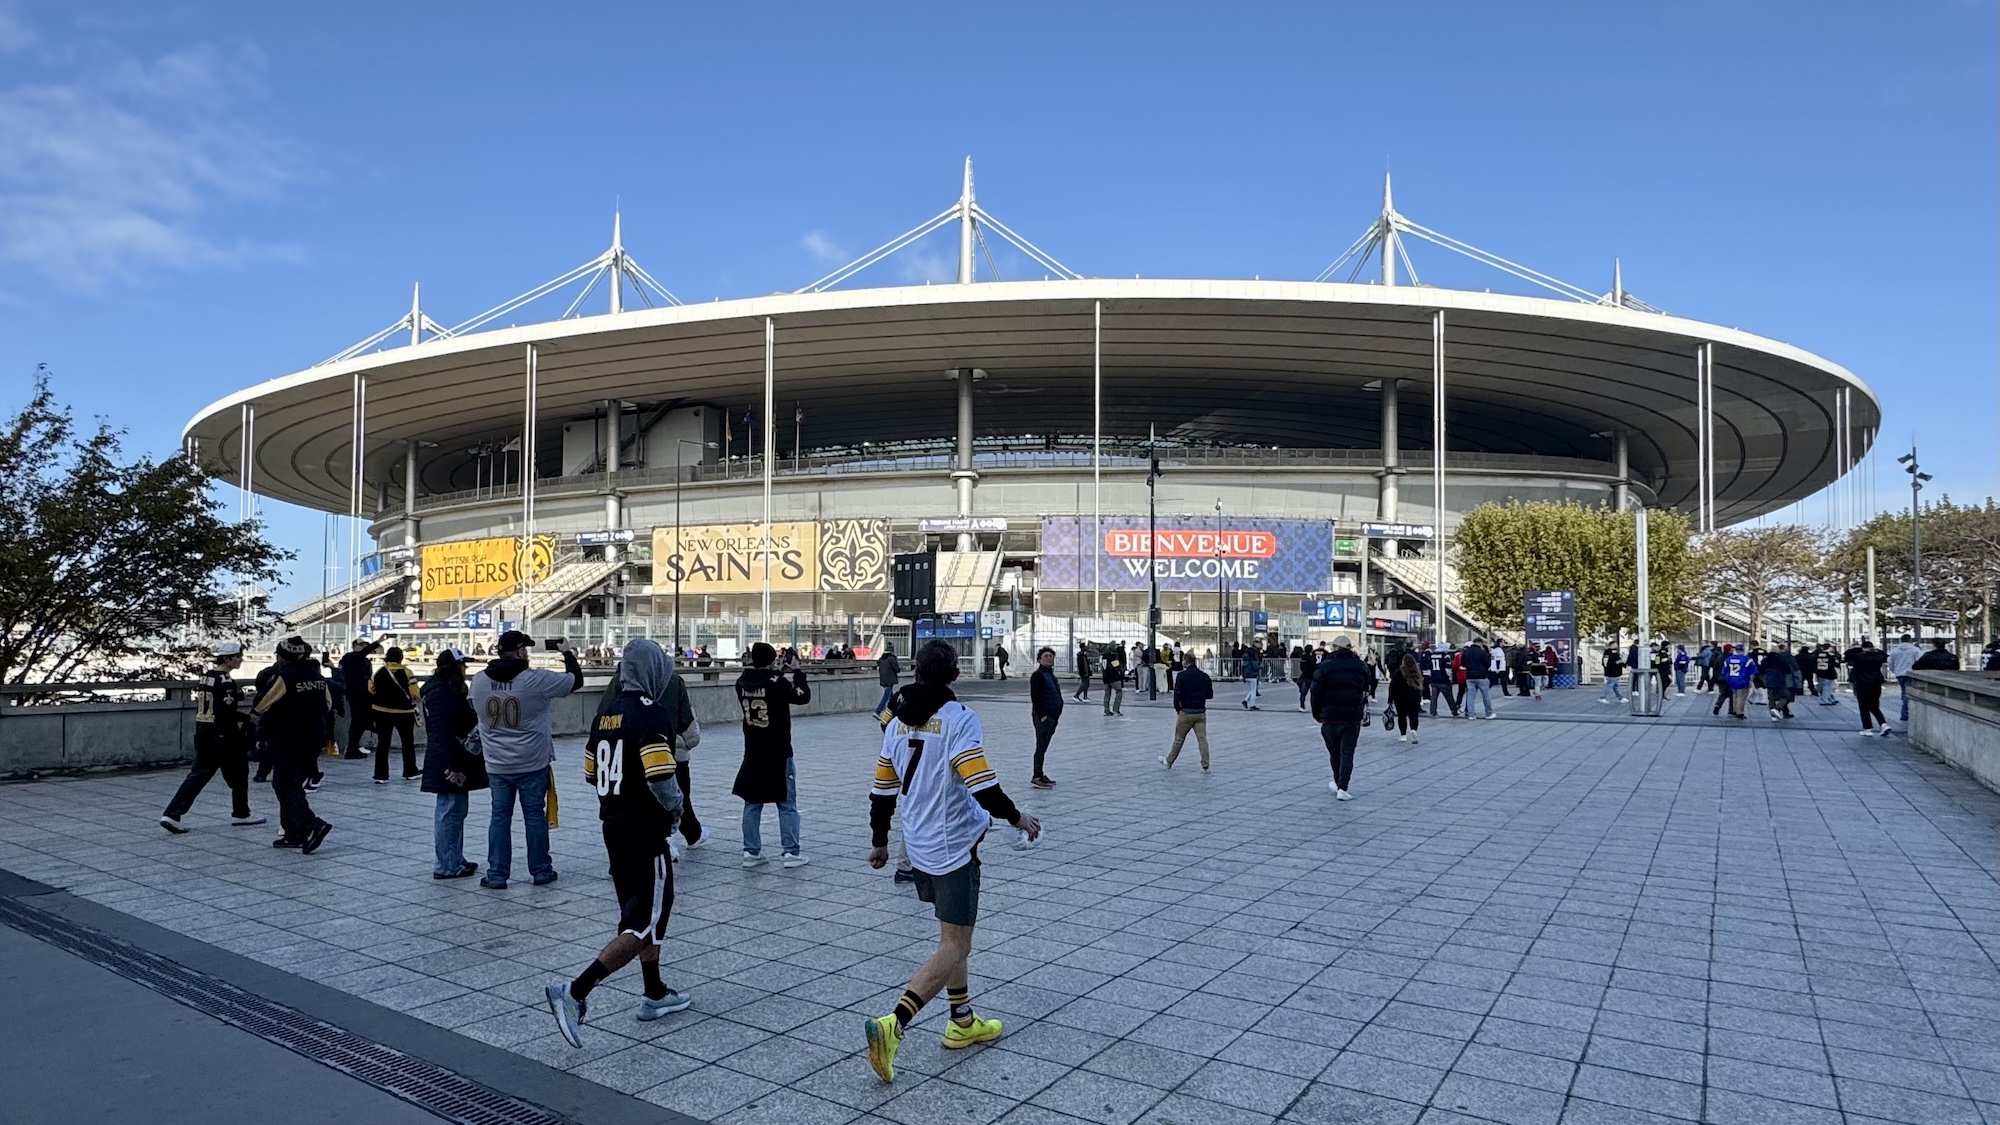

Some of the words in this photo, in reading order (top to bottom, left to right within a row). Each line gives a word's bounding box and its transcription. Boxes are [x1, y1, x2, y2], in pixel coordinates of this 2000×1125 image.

[678, 539, 713, 551] NEW
[716, 536, 790, 555] ORLEANS
[1114, 533, 1267, 553] BIENVENUE
[666, 550, 804, 582] SAINTS
[1123, 559, 1259, 578] WELCOME
[426, 562, 508, 591] STEELERS
[1330, 606, 1340, 617] A
[1729, 664, 1741, 676] 12
[296, 681, 325, 692] SAINTS
[491, 681, 513, 691] WATT
[486, 696, 521, 729] 90
[599, 714, 624, 730] BROWN
[742, 699, 769, 727] 13
[597, 739, 623, 796] 84
[902, 739, 925, 796] 7
